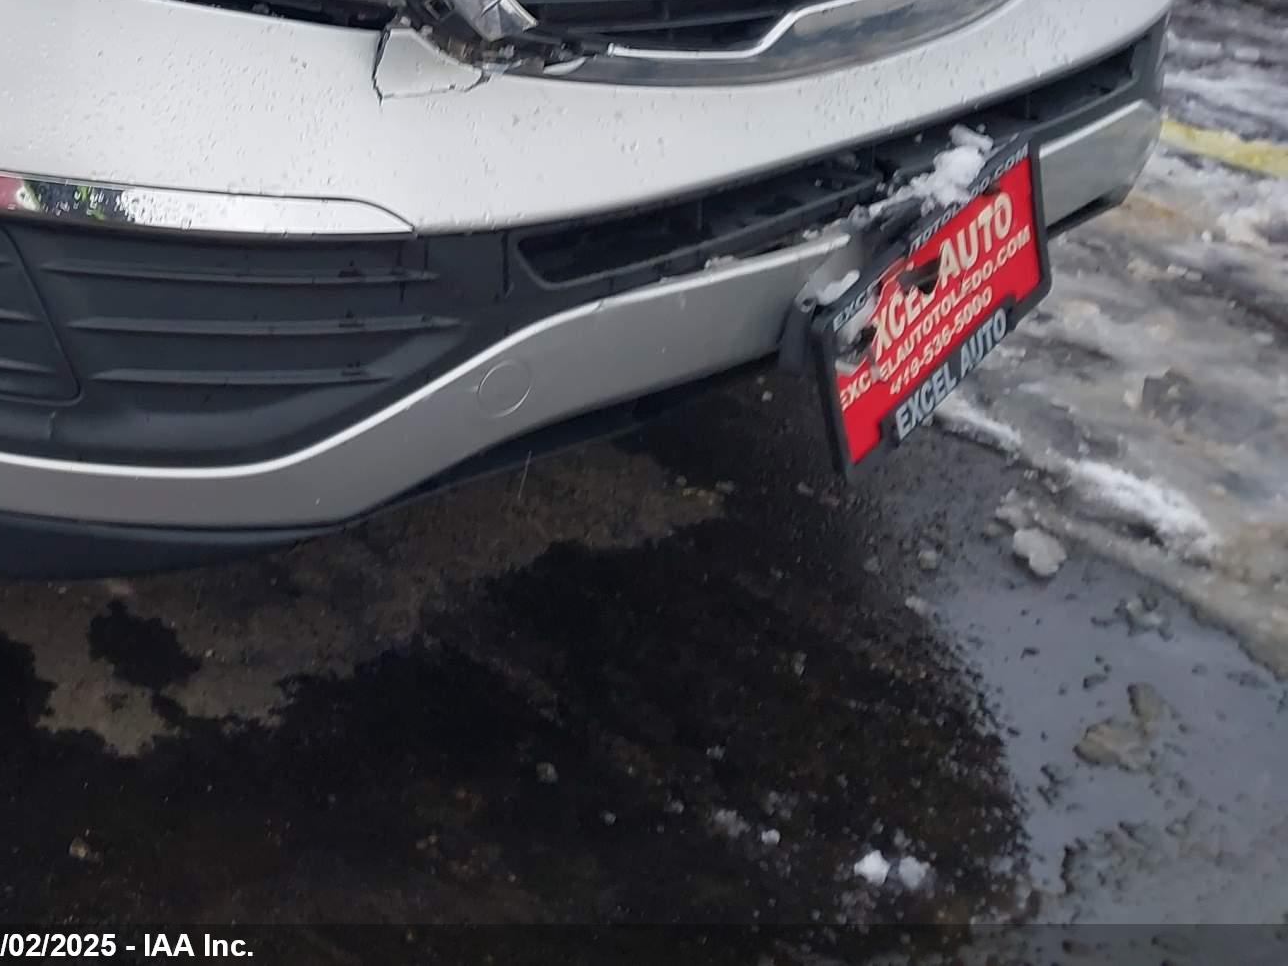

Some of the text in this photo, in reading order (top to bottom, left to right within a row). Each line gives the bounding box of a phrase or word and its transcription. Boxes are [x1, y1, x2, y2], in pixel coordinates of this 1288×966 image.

[873, 191, 1013, 363] XCE AUTO
[889, 285, 992, 395] 419-536-5000
[895, 307, 1007, 440] EXCEL AUTO
